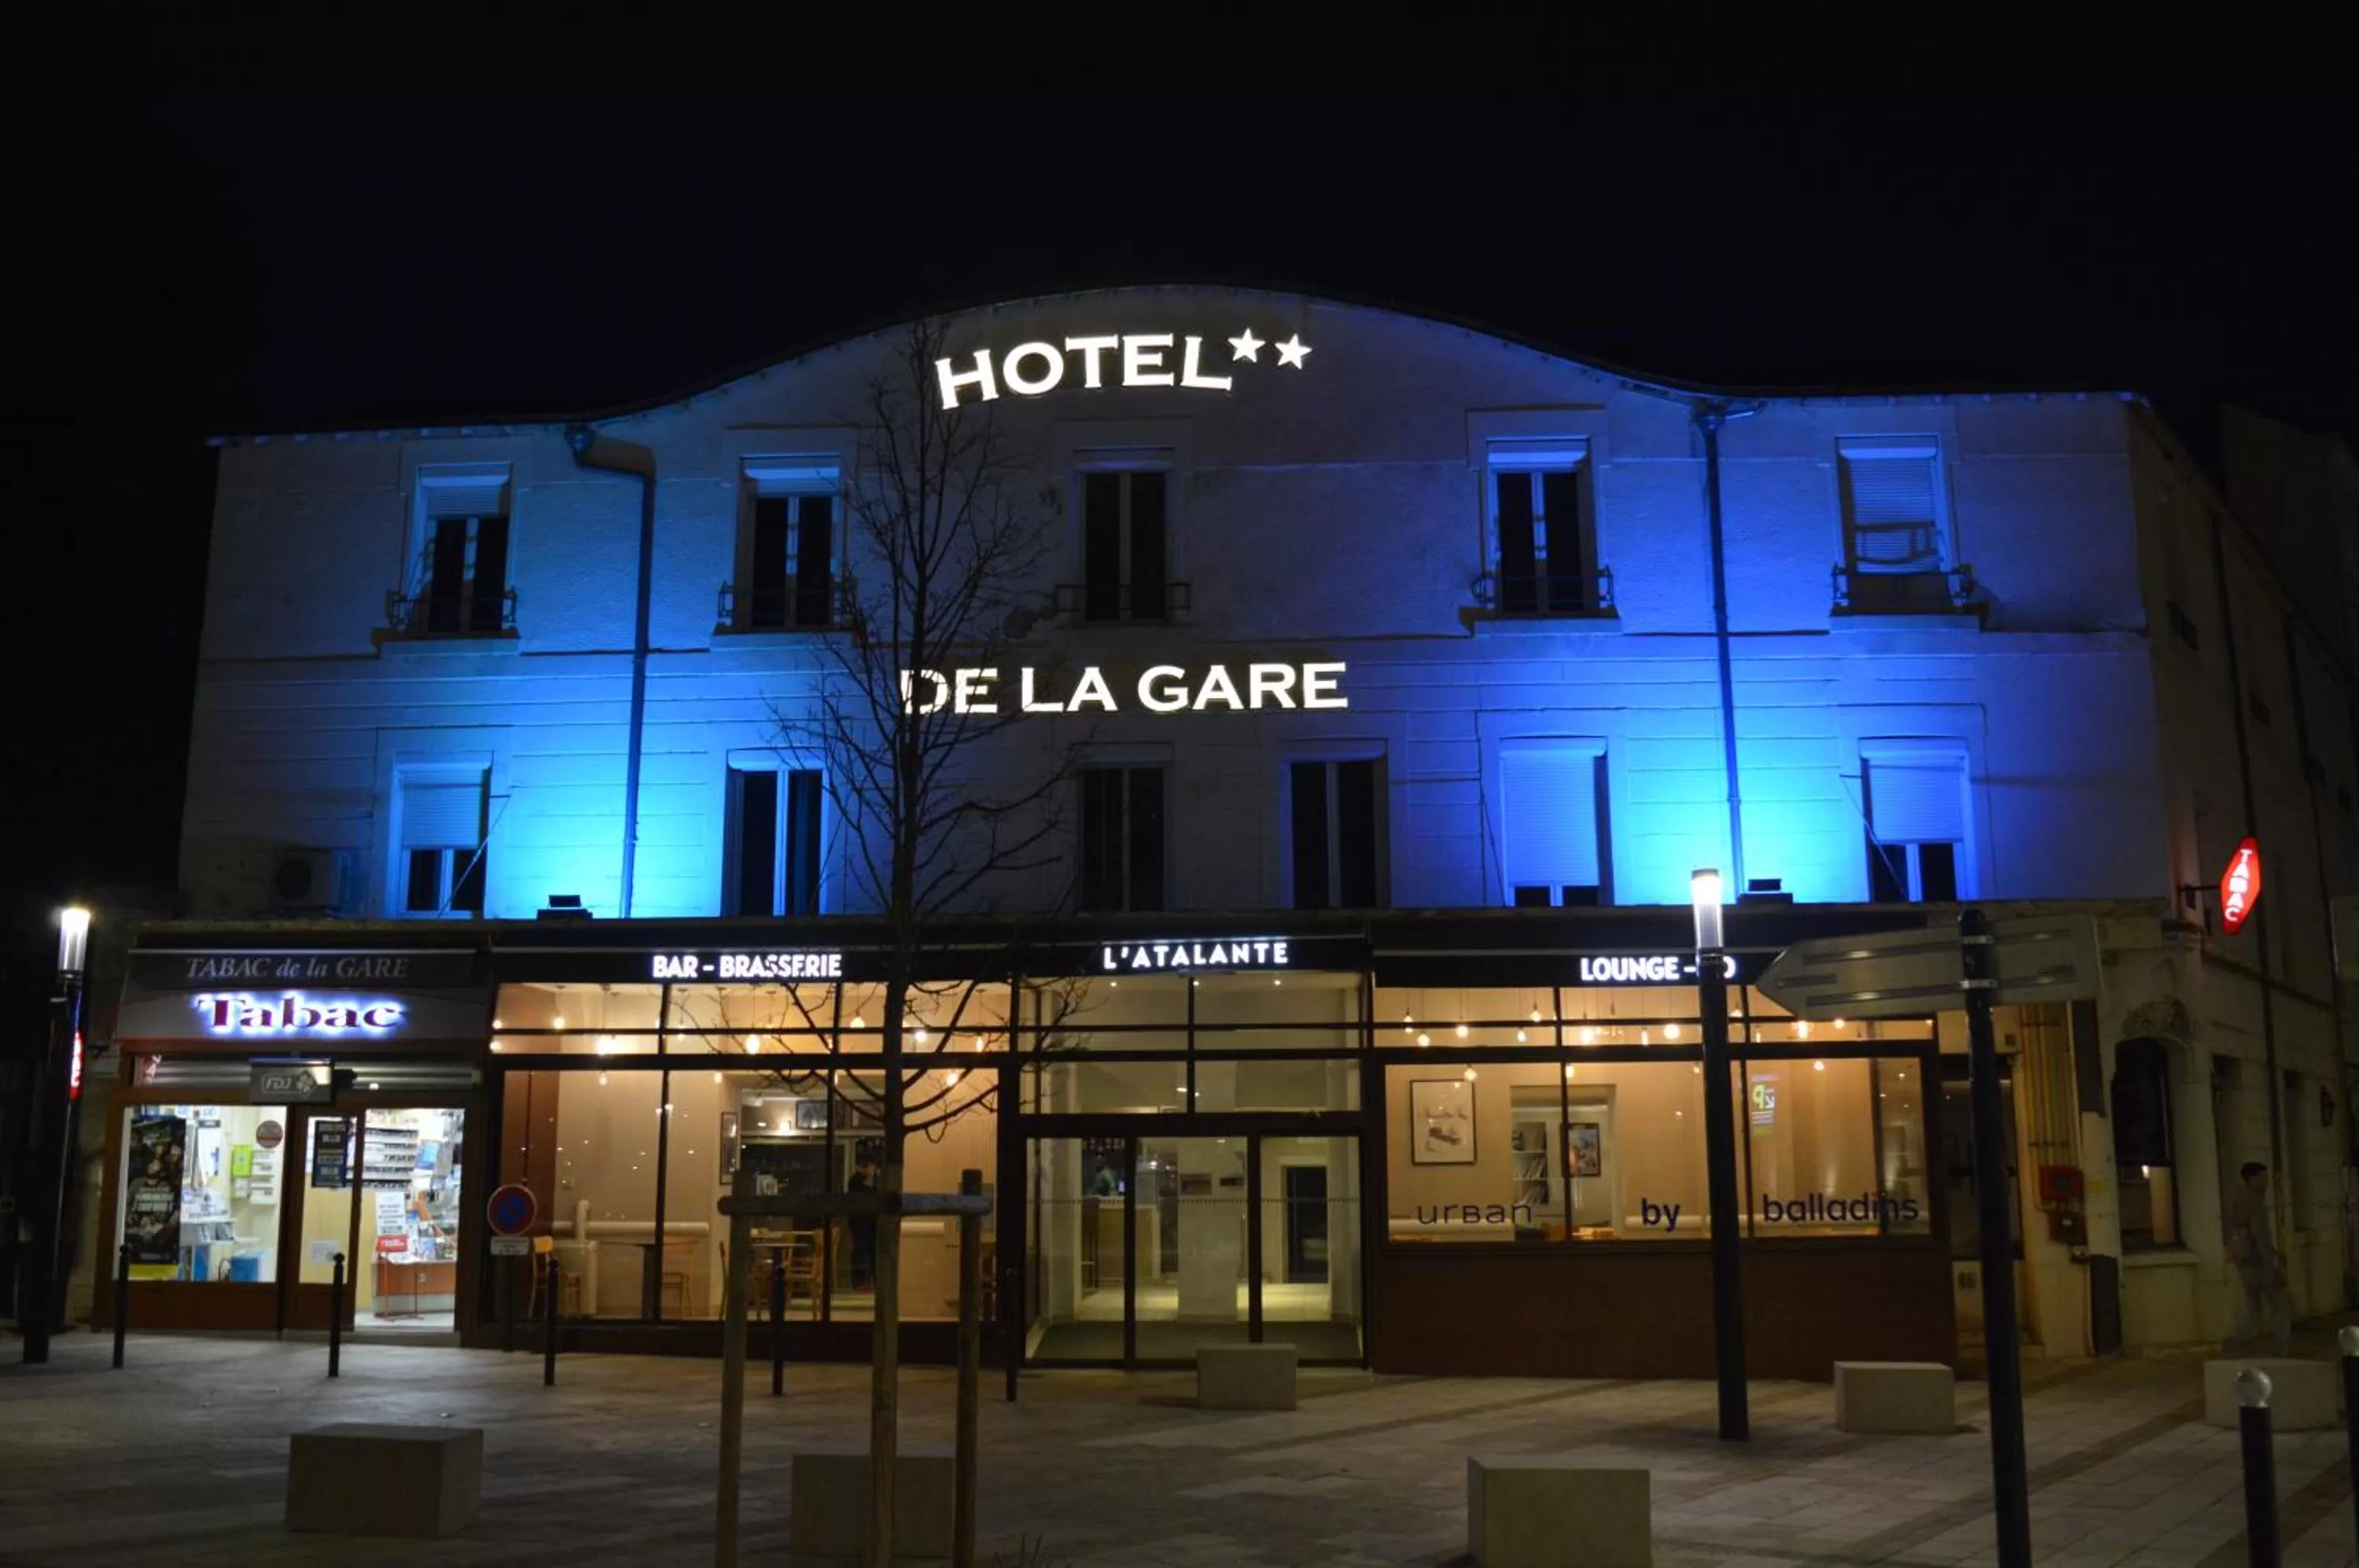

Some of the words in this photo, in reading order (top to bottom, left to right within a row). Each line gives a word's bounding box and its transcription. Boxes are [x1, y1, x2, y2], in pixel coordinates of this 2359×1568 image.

[936, 333, 1232, 410] HOTEL
[901, 666, 999, 715] DE
[1021, 664, 1118, 713] LA
[1137, 661, 1349, 712] GARE
[2224, 848, 2254, 922] TABAC
[186, 957, 270, 978] TABAC
[276, 956, 300, 977] de
[307, 955, 329, 977] la
[336, 956, 410, 978] GARE
[653, 954, 698, 978] BAR
[719, 953, 843, 978] BRASSERIE
[1103, 942, 1289, 970] L'ATALANTE
[1580, 956, 1680, 981] LOUNGE
[195, 992, 406, 1029] Tabac
[266, 1076, 293, 1090] FDJ
[1640, 1196, 1681, 1232] by
[1761, 1191, 1920, 1223] balladins
